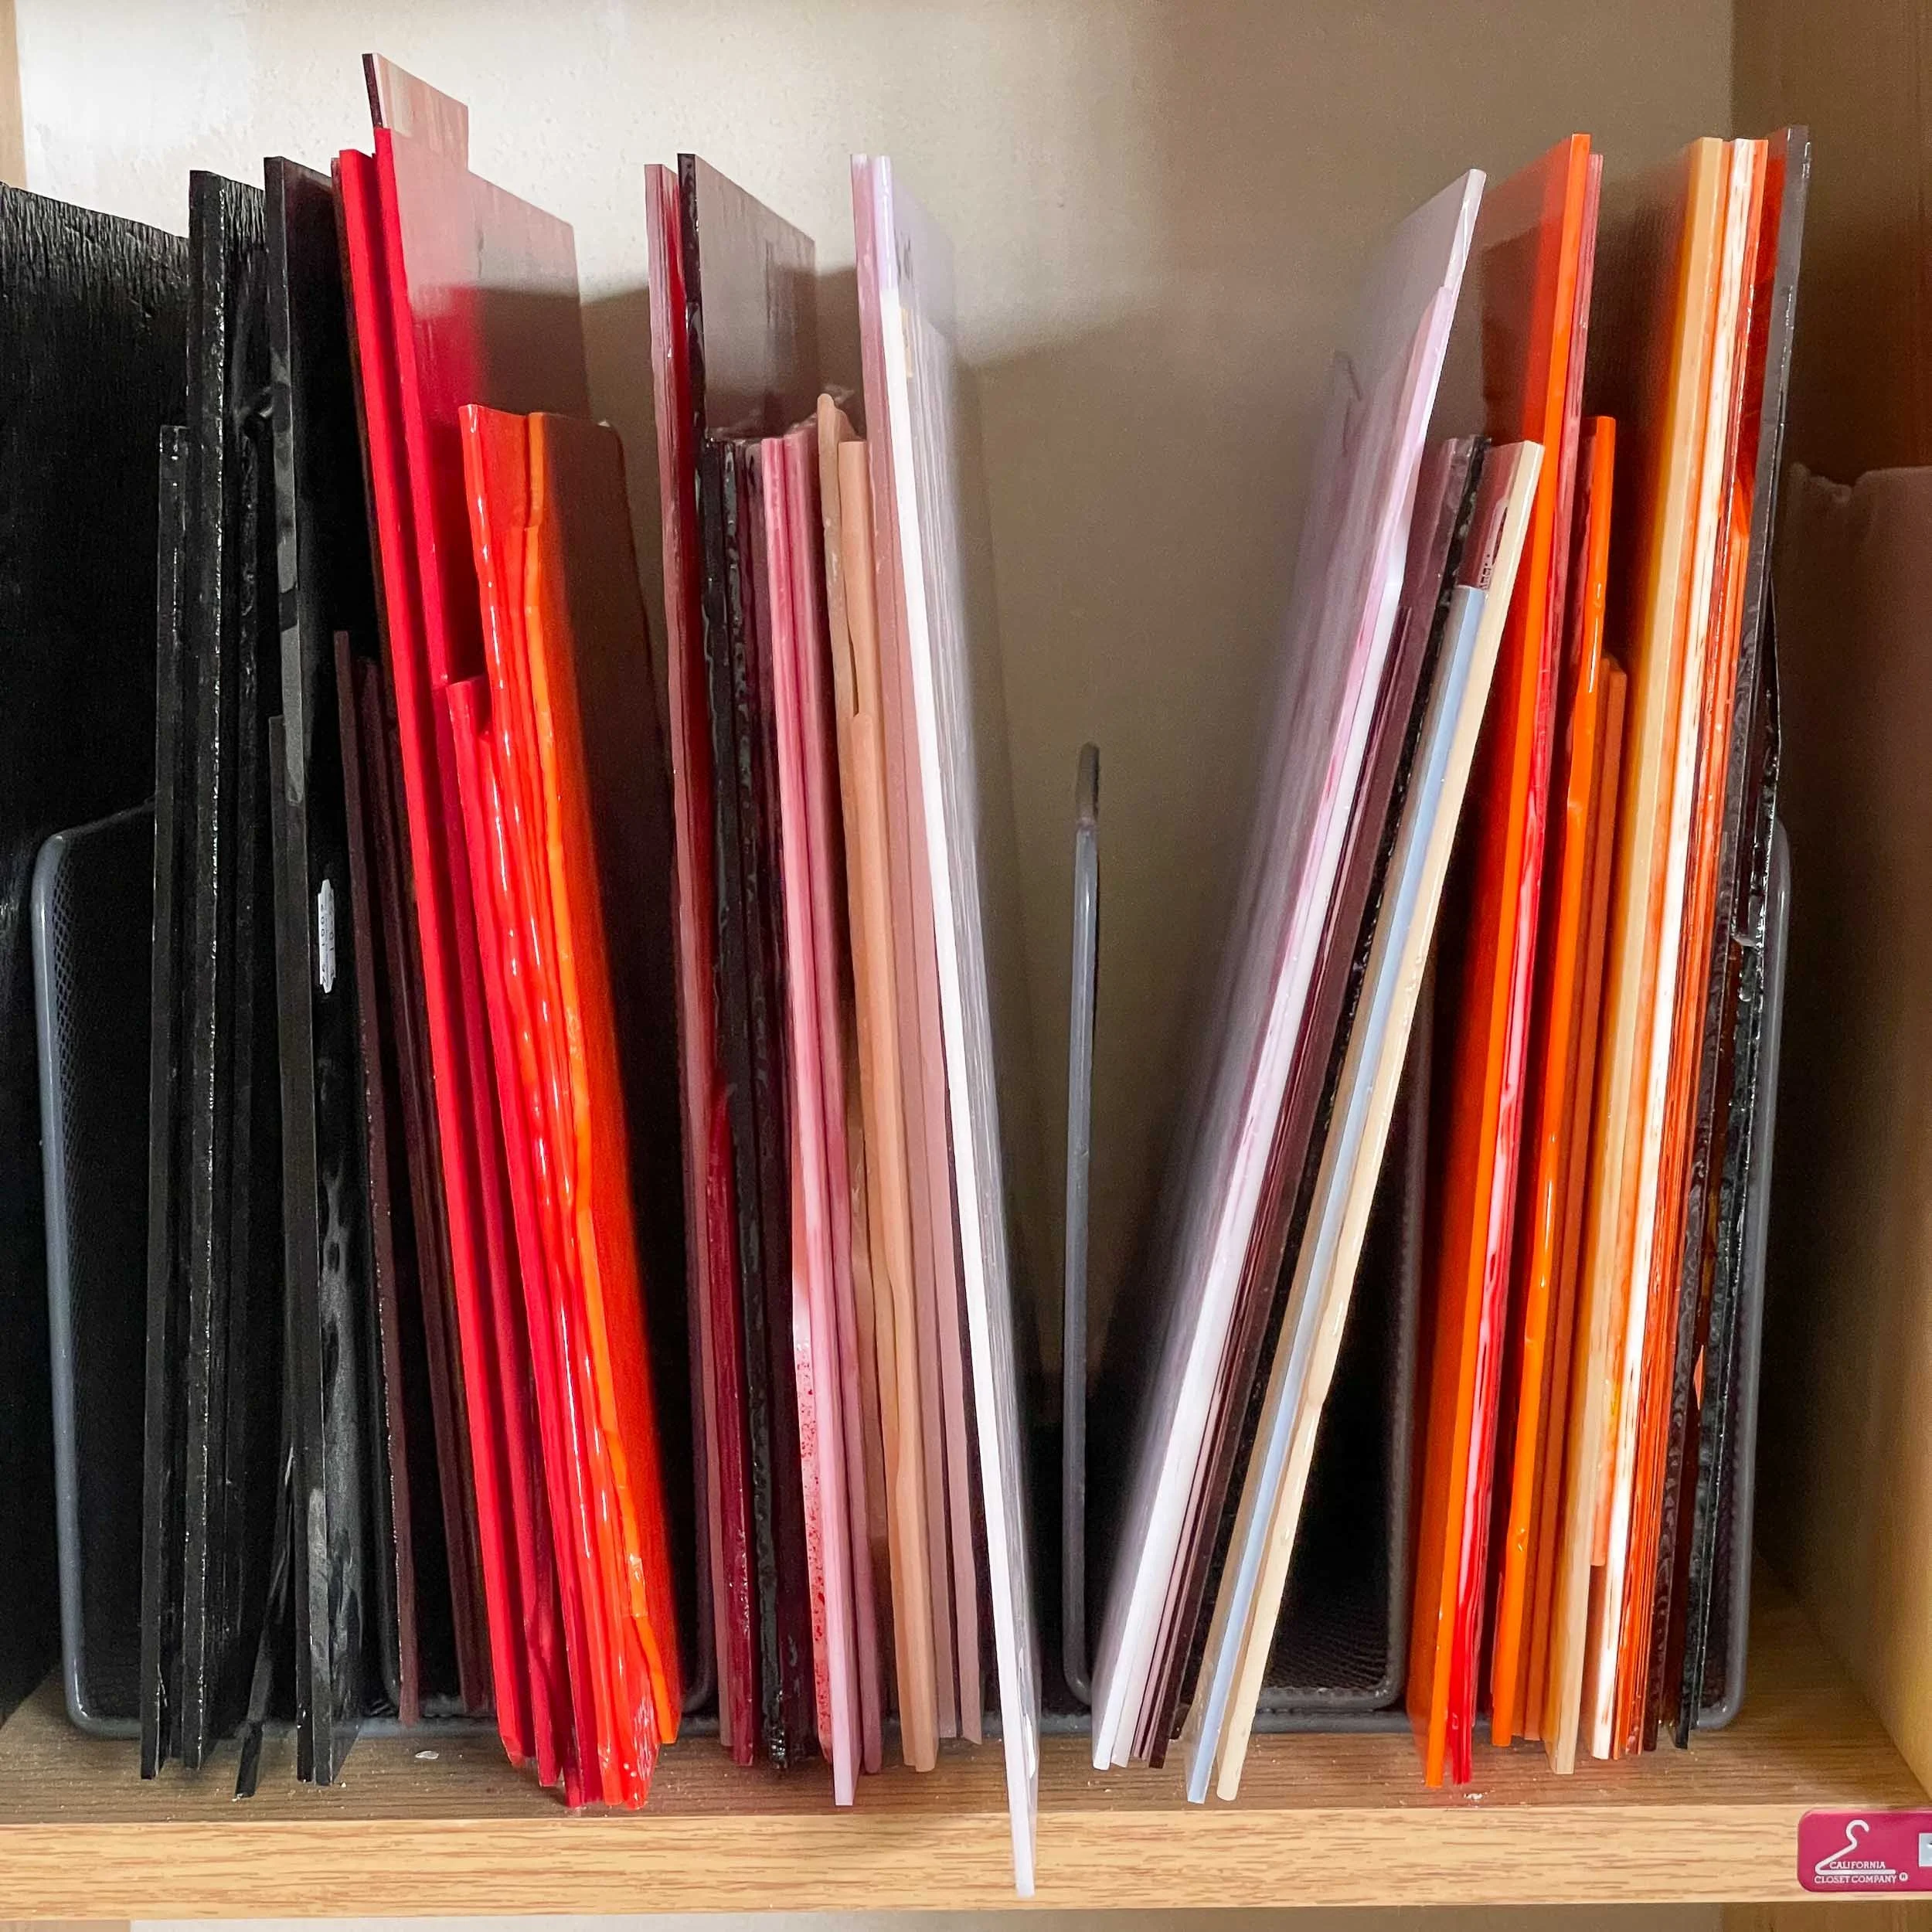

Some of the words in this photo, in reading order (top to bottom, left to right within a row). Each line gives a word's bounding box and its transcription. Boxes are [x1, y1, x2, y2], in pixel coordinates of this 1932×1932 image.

[1829, 1861, 1886, 1869] CALIFORNIA
[1814, 1876, 1850, 1884] CLOSET
[1851, 1875, 1897, 1883] COMPANY
